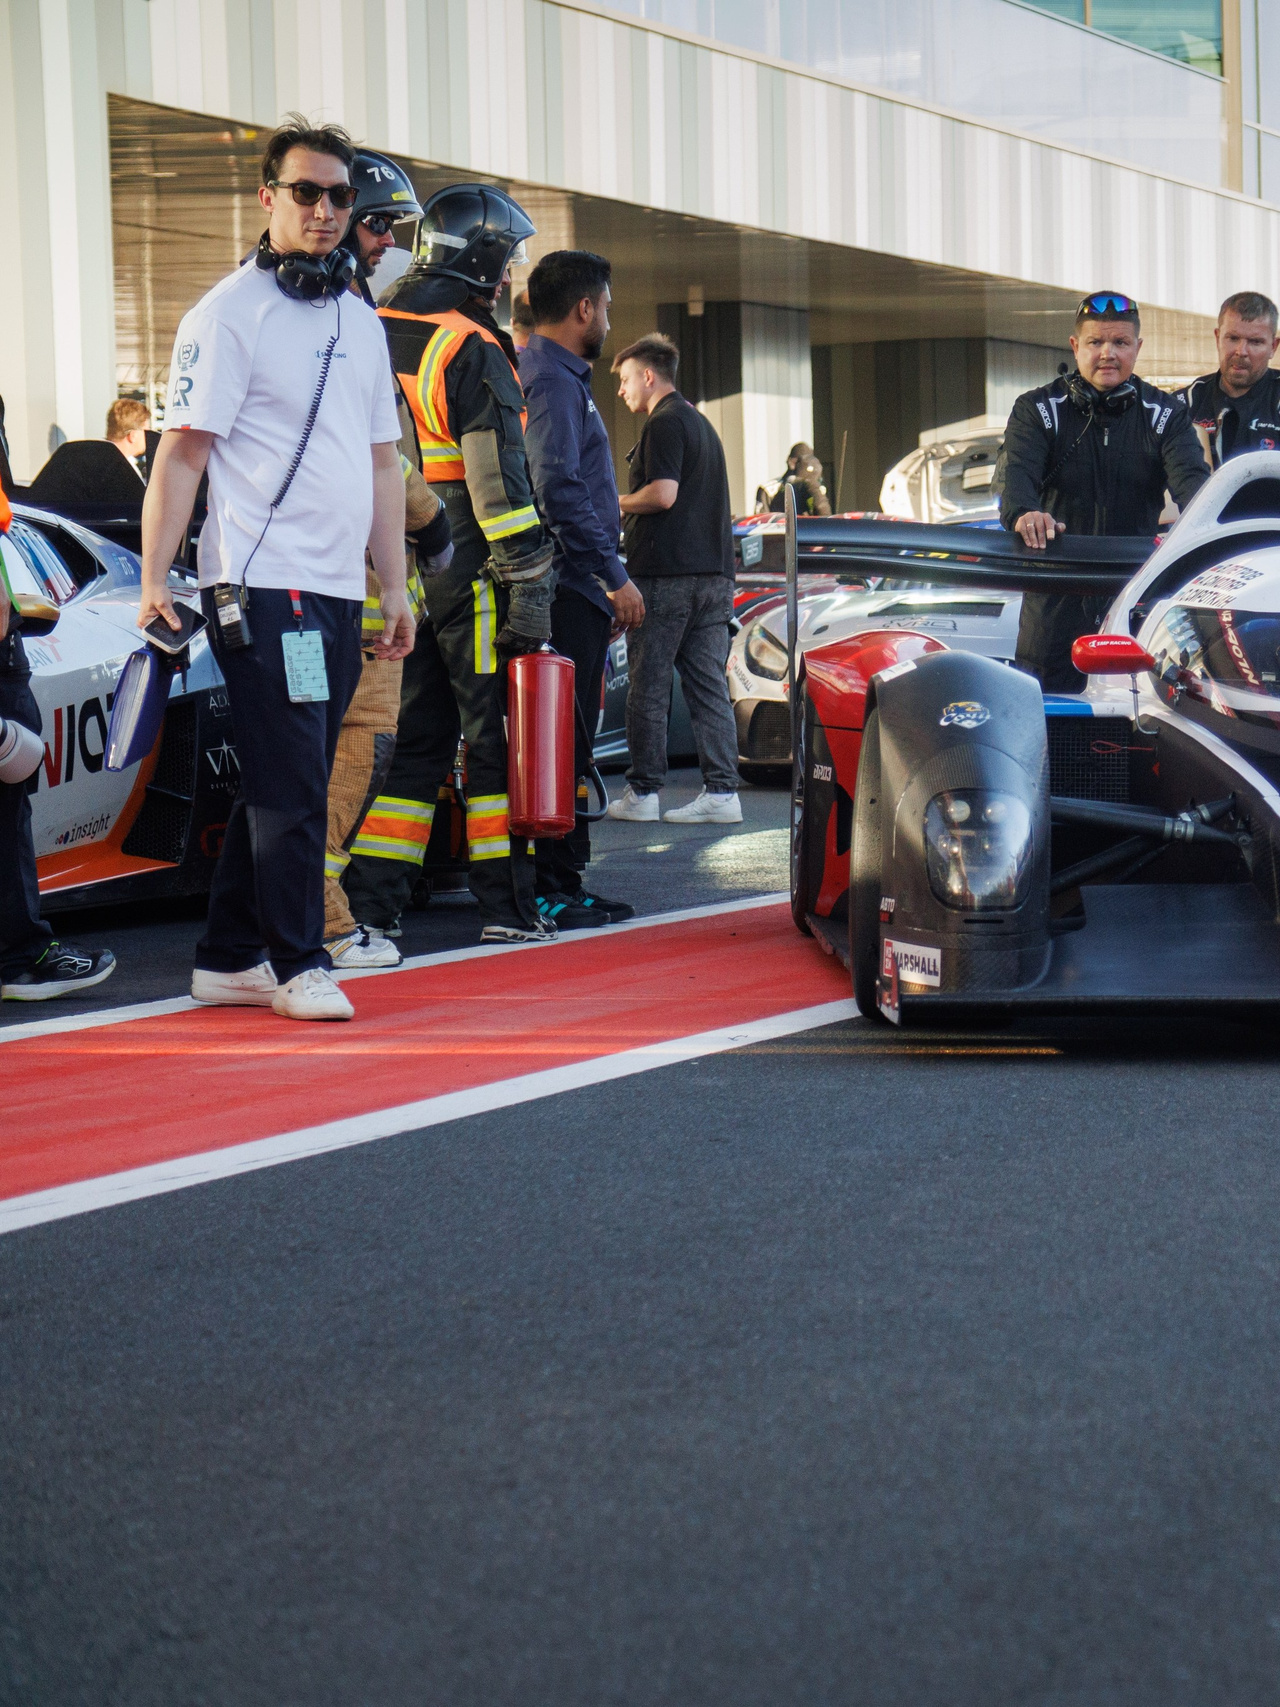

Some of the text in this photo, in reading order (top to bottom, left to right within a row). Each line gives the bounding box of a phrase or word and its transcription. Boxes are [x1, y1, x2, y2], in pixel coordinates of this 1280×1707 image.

[366, 166, 396, 183] 76
[1036, 402, 1053, 429] sparco
[1155, 407, 1173, 434] sparco
[69, 813, 110, 843] insight
